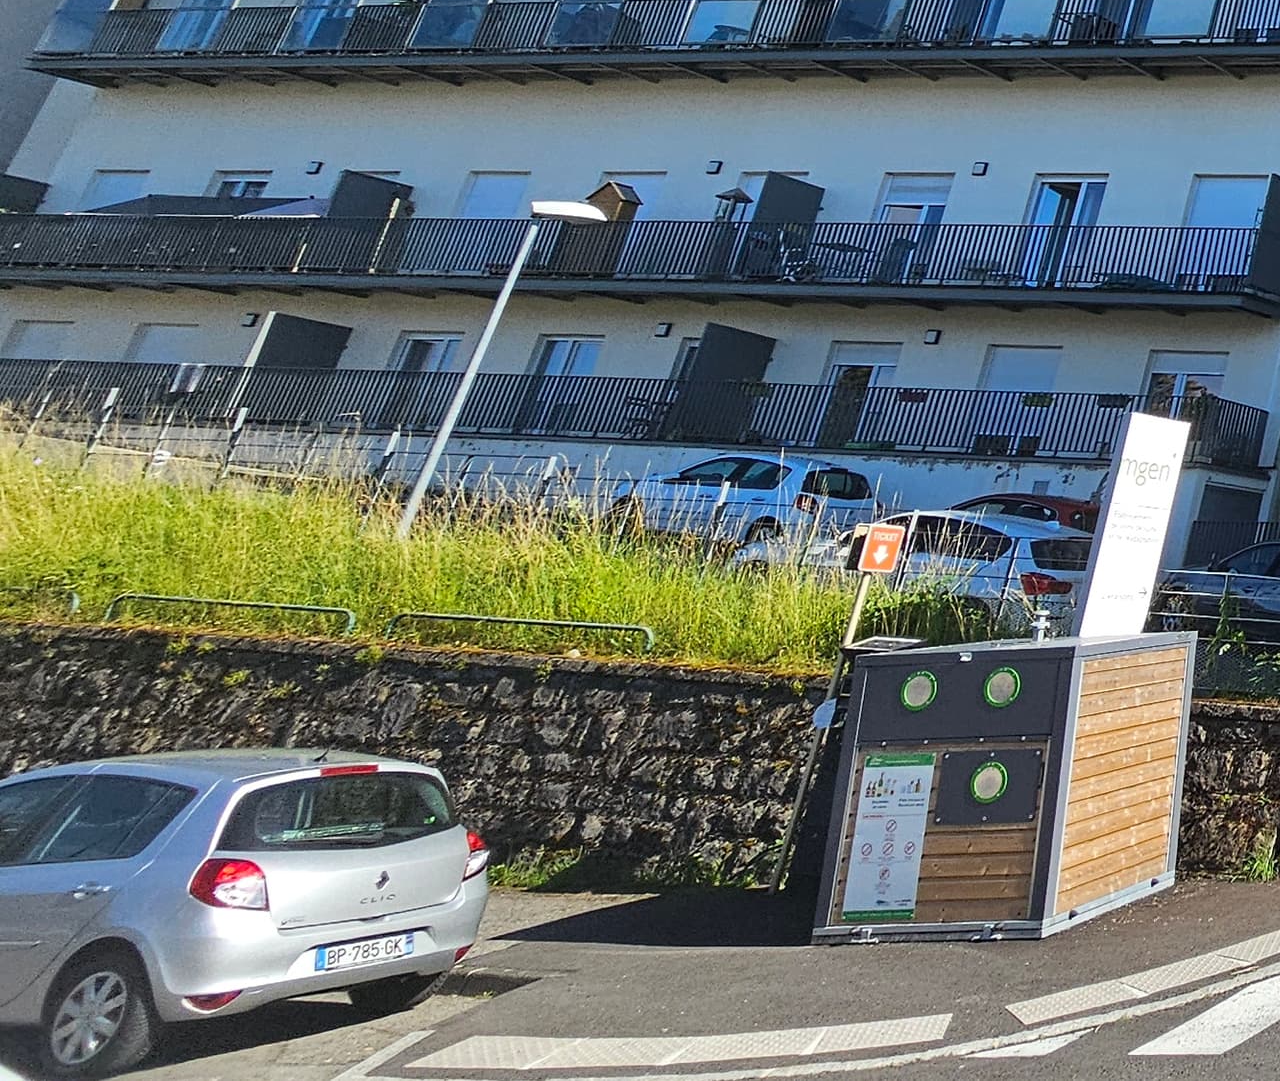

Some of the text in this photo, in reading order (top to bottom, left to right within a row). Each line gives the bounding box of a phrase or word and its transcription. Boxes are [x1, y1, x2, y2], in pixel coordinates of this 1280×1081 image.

[1122, 456, 1170, 486] mgen
[873, 531, 899, 542] TICKET
[360, 893, 396, 904] CLIO
[327, 937, 403, 966] BP-785-GK
